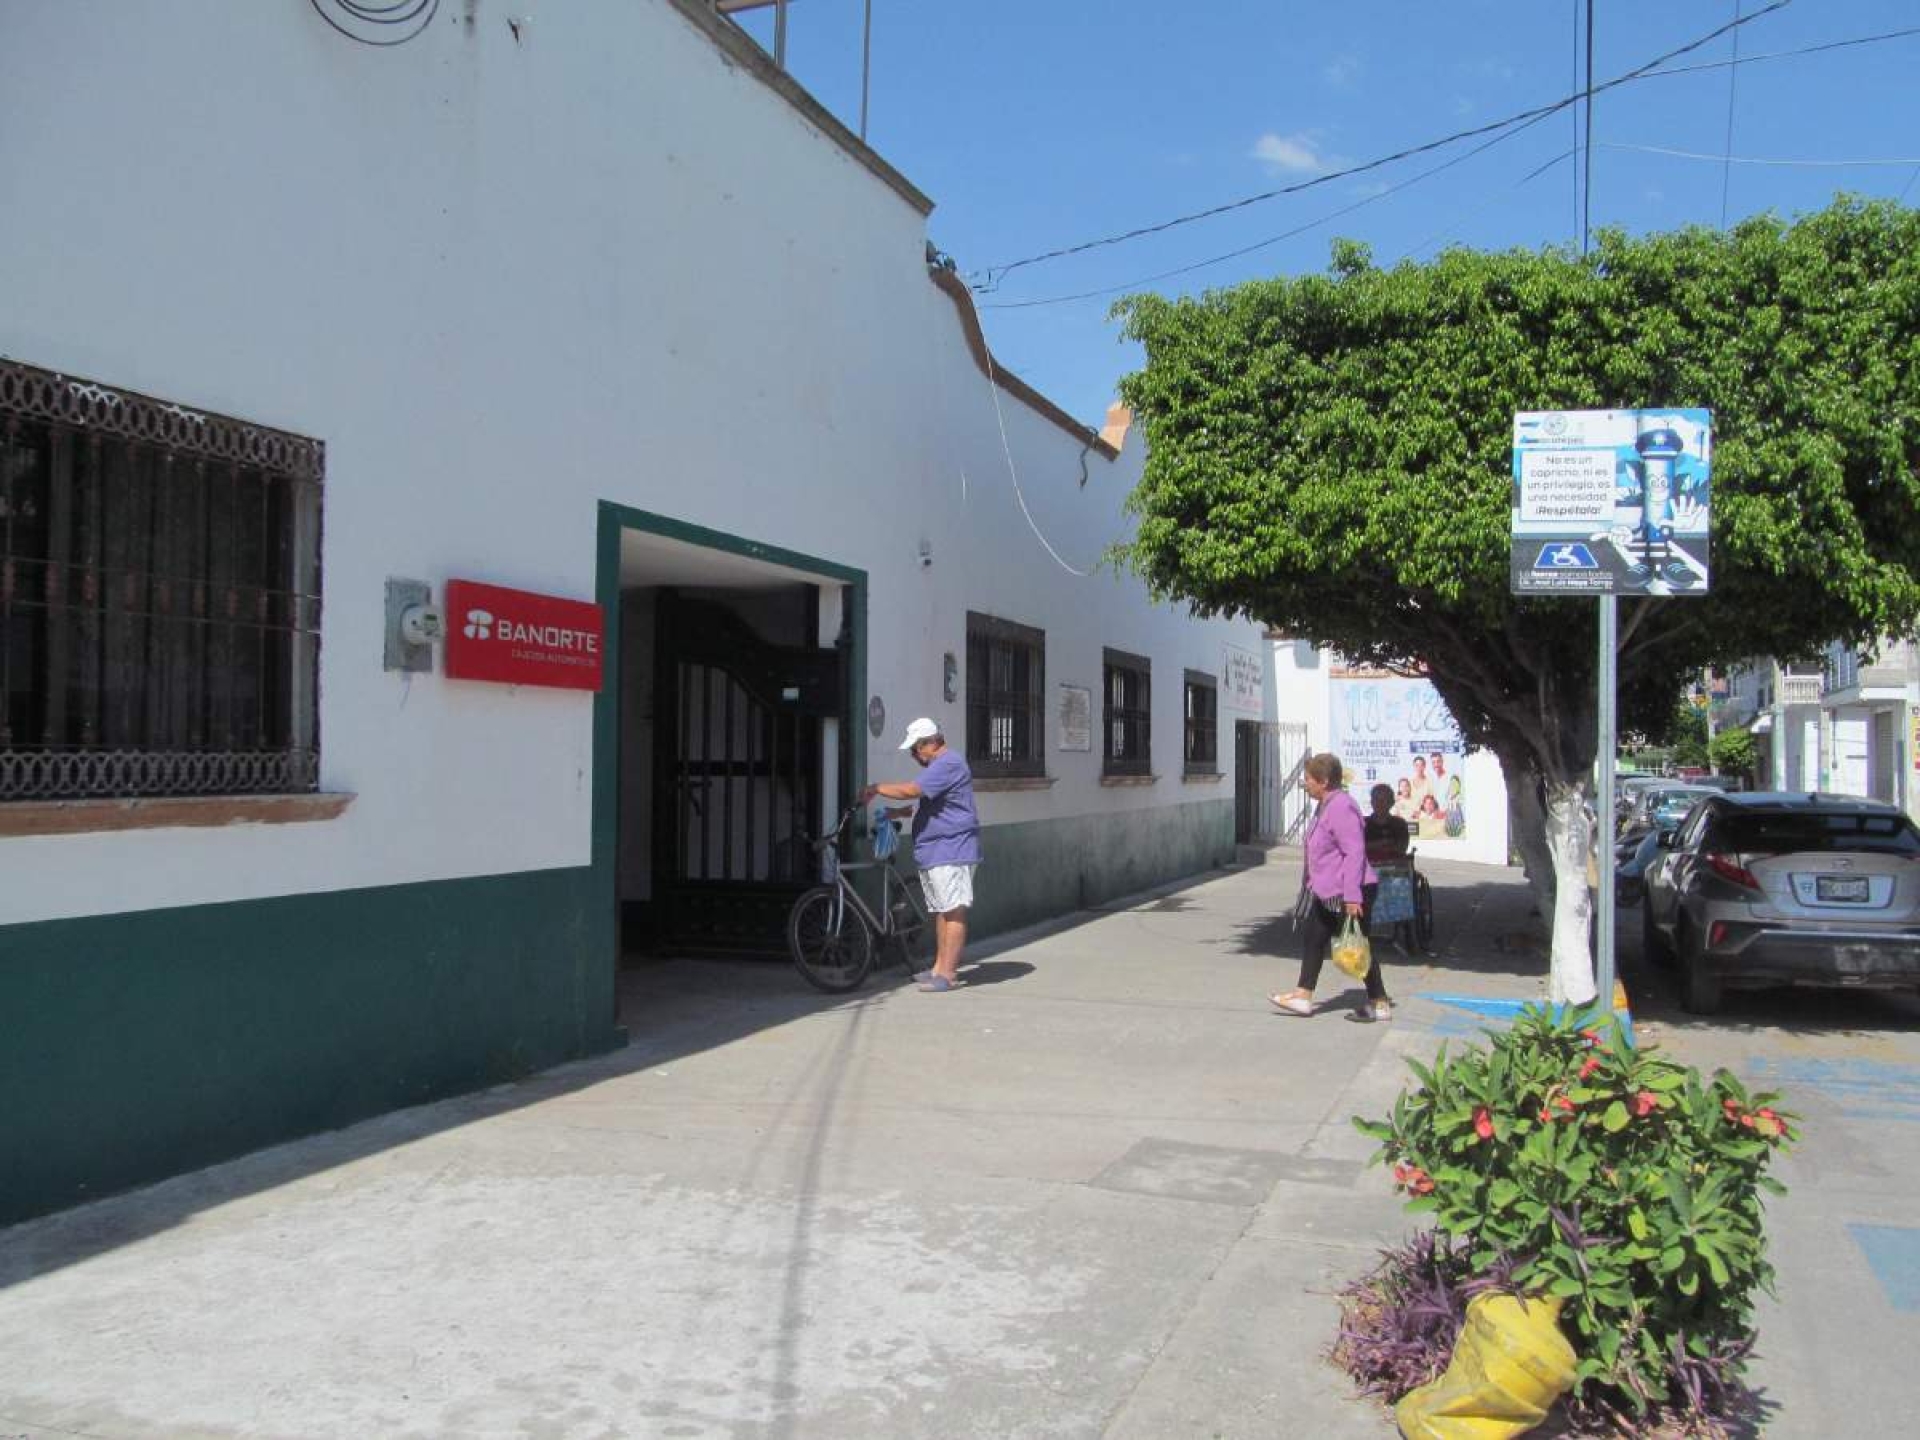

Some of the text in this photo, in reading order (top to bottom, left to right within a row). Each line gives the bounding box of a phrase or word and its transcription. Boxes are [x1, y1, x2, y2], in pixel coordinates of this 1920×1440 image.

[1546, 456, 1593, 465] No es un
[1530, 468, 1582, 478] capricho,
[1583, 468, 1593, 476] ni
[1543, 480, 1596, 491] privilegio,
[1598, 481, 1611, 489] es
[1527, 494, 1548, 502] una
[498, 619, 599, 653] BANORTE
